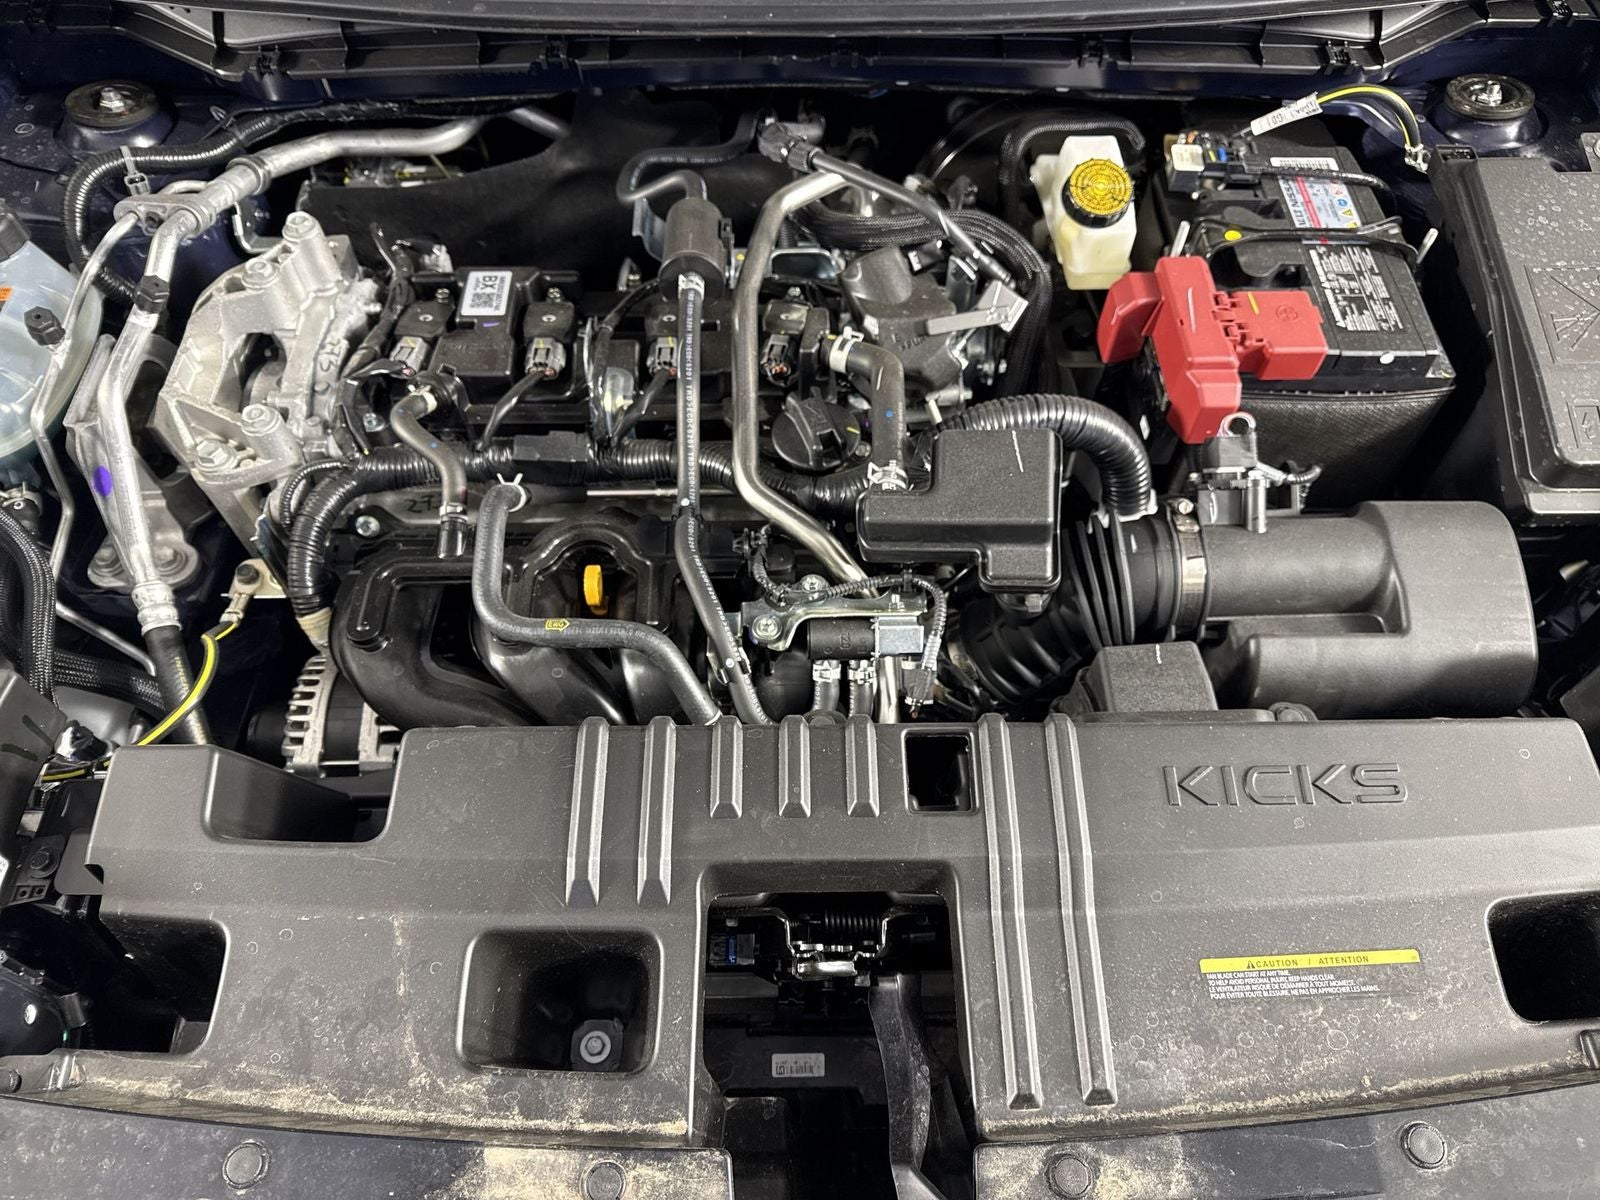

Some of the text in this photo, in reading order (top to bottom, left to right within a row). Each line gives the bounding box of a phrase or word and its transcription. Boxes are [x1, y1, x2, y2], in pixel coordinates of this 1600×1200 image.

[480, 275, 498, 290] BX
[1163, 763, 1408, 806] KICKS
[1256, 959, 1298, 968] CAUTION
[1318, 955, 1369, 965] ATTENTION
[1252, 983, 1271, 991] RISQUE
[1319, 986, 1350, 994] APPROCHER
